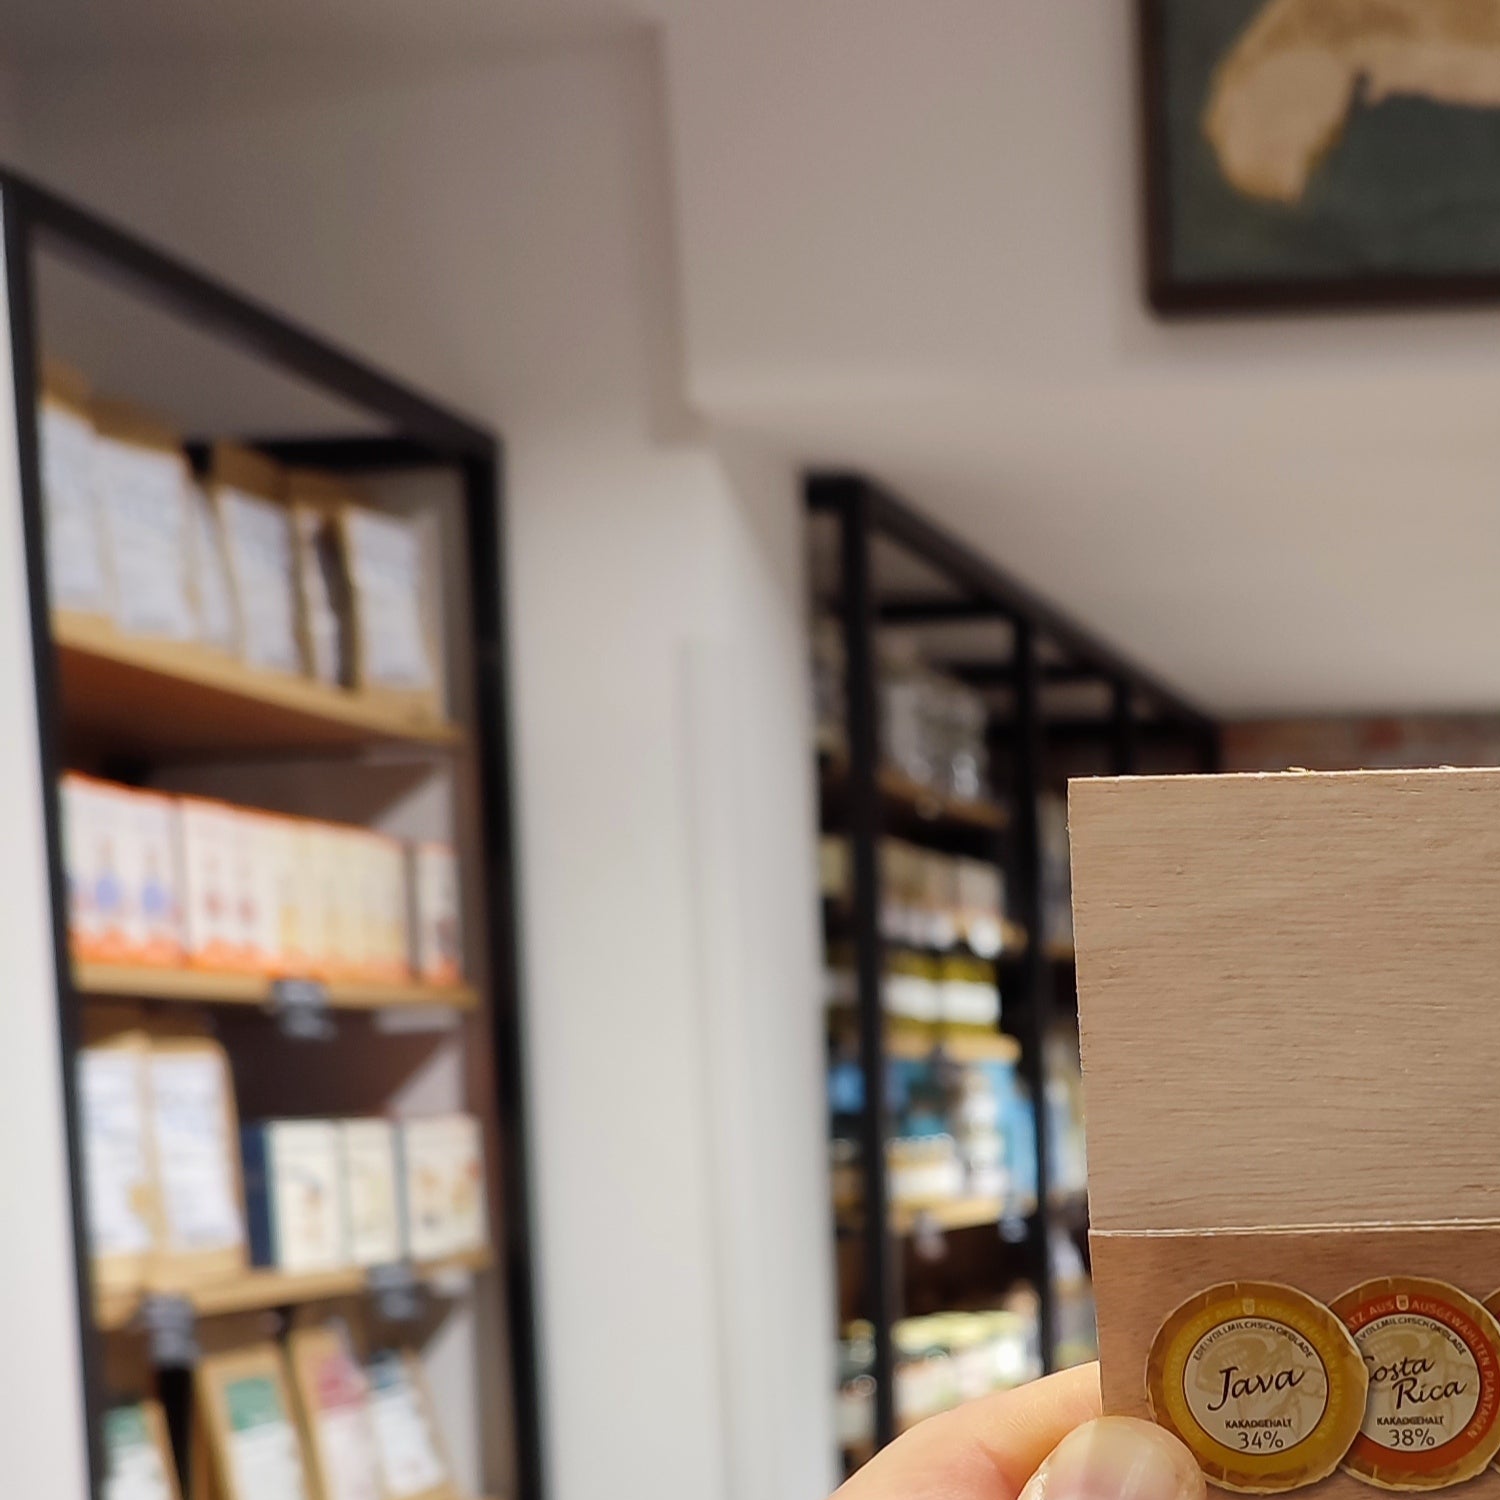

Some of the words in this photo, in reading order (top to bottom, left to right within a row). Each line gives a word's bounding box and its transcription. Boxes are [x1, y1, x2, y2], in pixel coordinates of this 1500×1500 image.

[1369, 1302, 1394, 1316] AUS
[1207, 1366, 1305, 1411] Java
[1391, 1377, 1468, 1410] Rica
[1225, 1419, 1292, 1428] KAKAOGEHALT
[1377, 1416, 1444, 1426] KAKAOGEHALT
[1238, 1431, 1284, 1449] 34%
[1389, 1428, 1435, 1446] 38%
